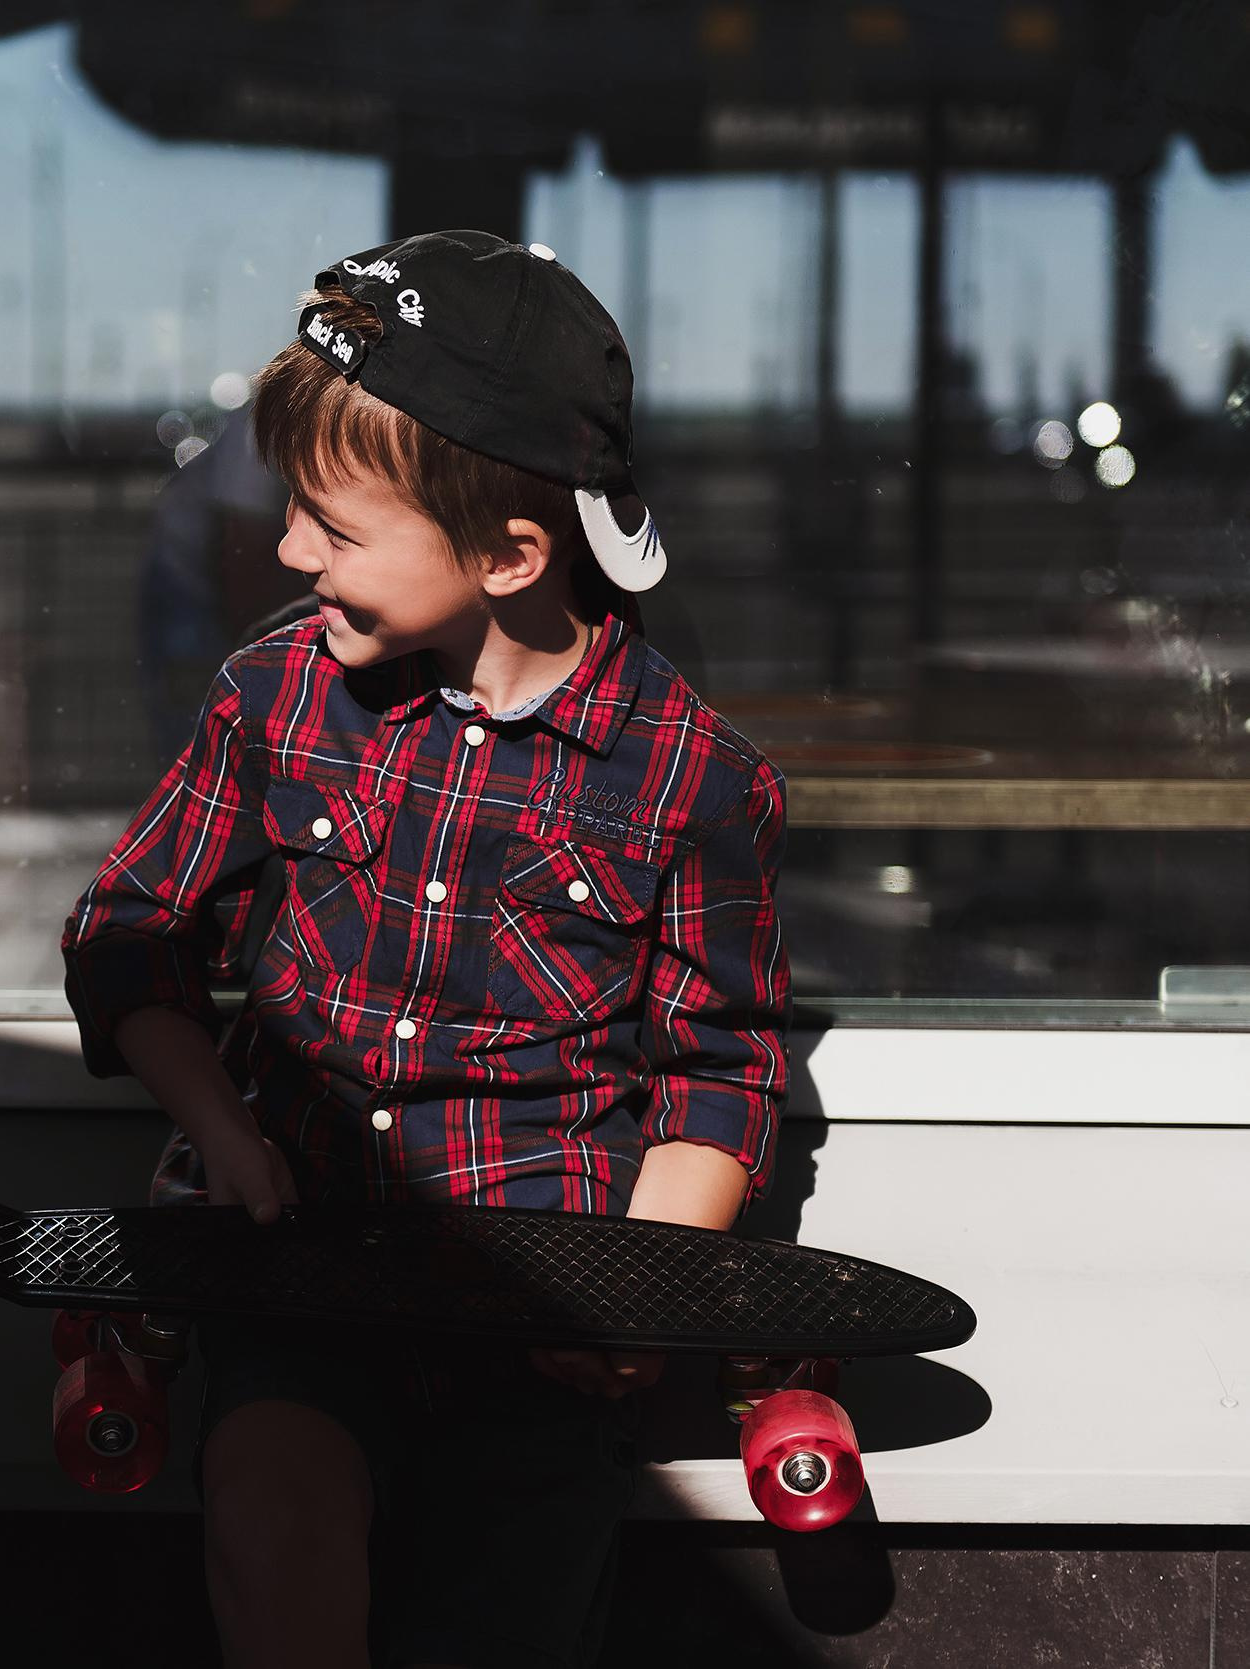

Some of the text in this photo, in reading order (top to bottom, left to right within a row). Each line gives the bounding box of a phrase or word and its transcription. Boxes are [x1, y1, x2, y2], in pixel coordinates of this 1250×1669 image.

[343, 259, 425, 328] Opic City
[331, 332, 354, 365] Sea
[526, 767, 650, 820] Custom
[540, 801, 661, 849] APPAREL
